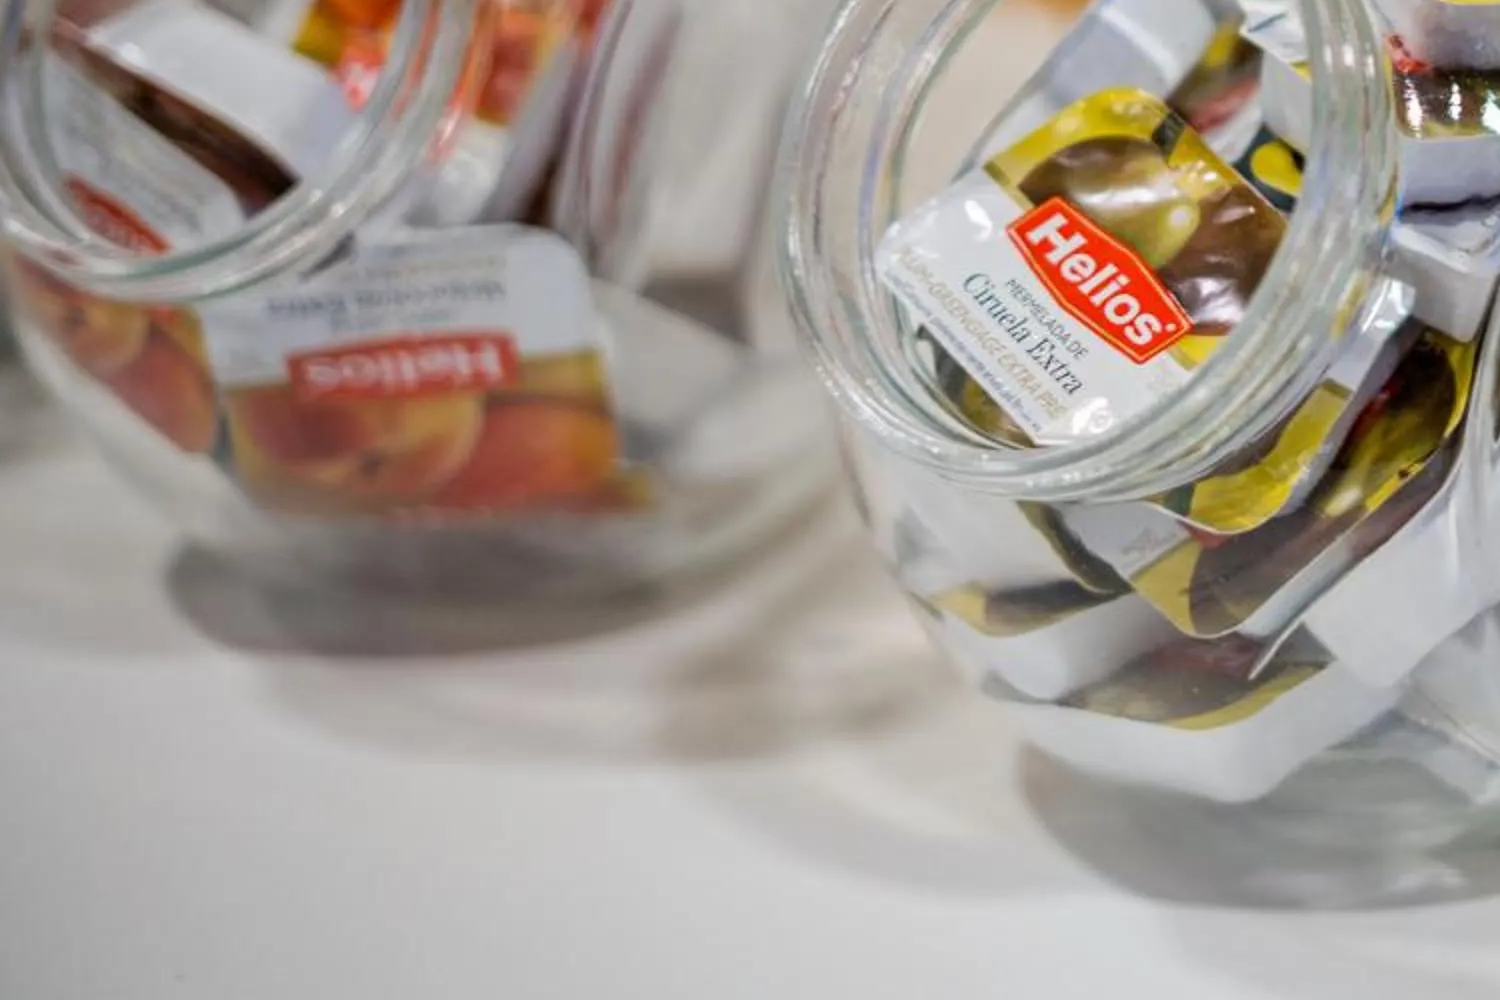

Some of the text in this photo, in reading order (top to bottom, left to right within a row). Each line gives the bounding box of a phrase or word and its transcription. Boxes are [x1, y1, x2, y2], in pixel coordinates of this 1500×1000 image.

[1004, 277, 1089, 361] MERMELADA DE
[1029, 212, 1164, 346] Helios
[304, 342, 502, 392] Helios
[961, 271, 1036, 344] Ciruela
[1025, 338, 1086, 395] Extra
